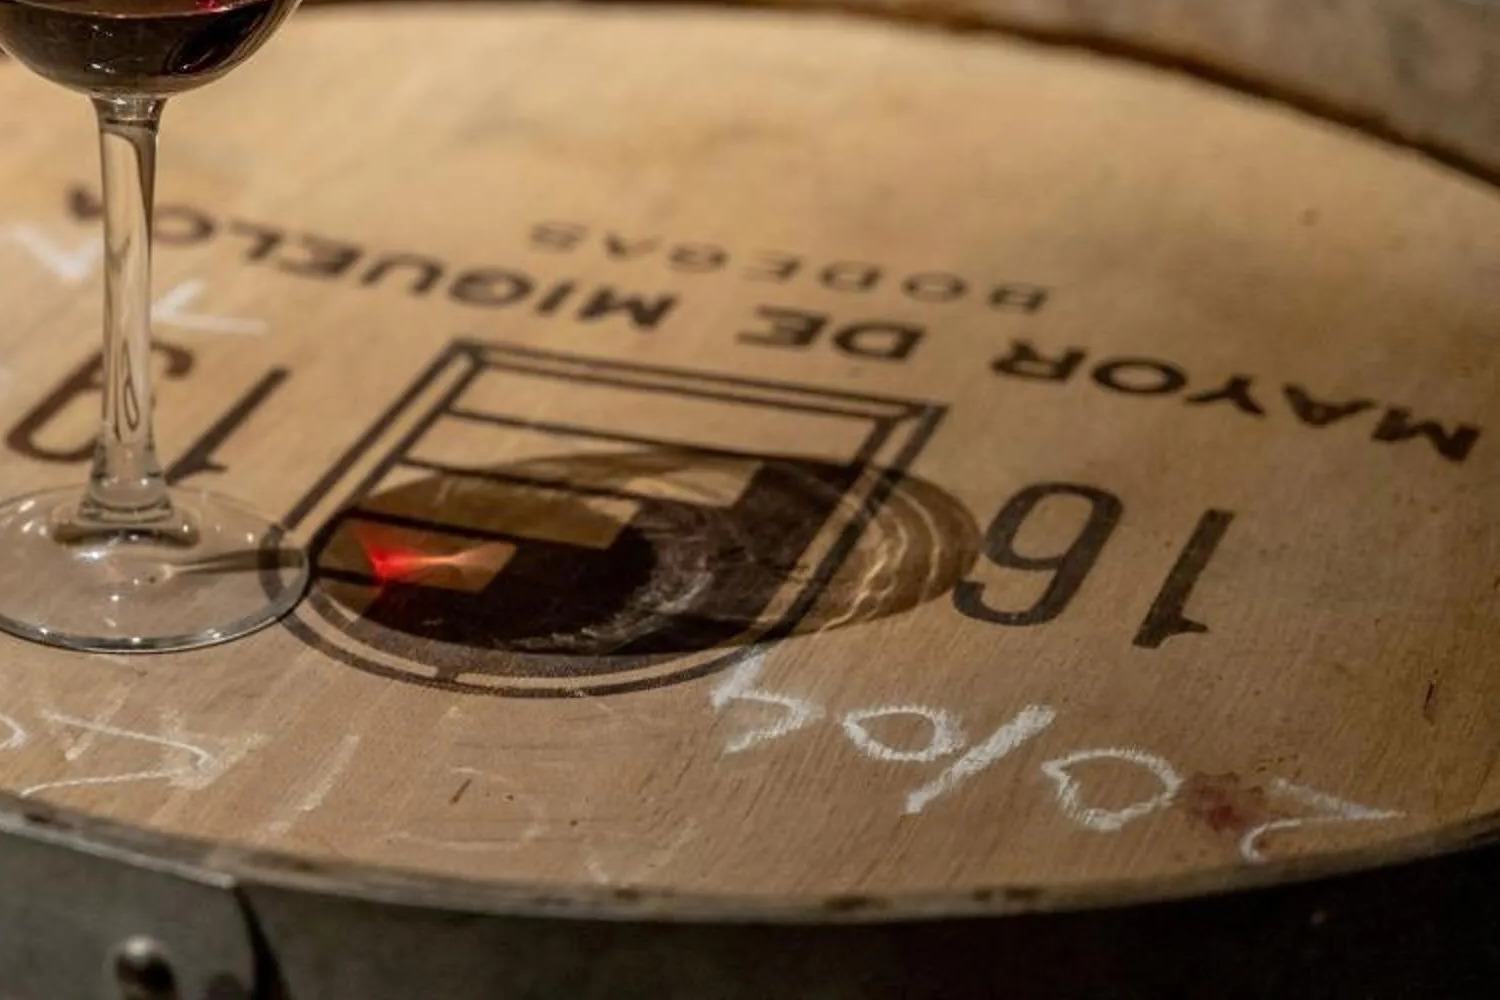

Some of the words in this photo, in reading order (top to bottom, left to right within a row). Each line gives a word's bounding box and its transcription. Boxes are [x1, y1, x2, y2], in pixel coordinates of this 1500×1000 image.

[530, 222, 1054, 314] BODEGAS
[738, 307, 926, 365] DE
[3, 340, 292, 487] 19
[991, 338, 1482, 463] MAYOR
[952, 481, 1236, 649] 16
